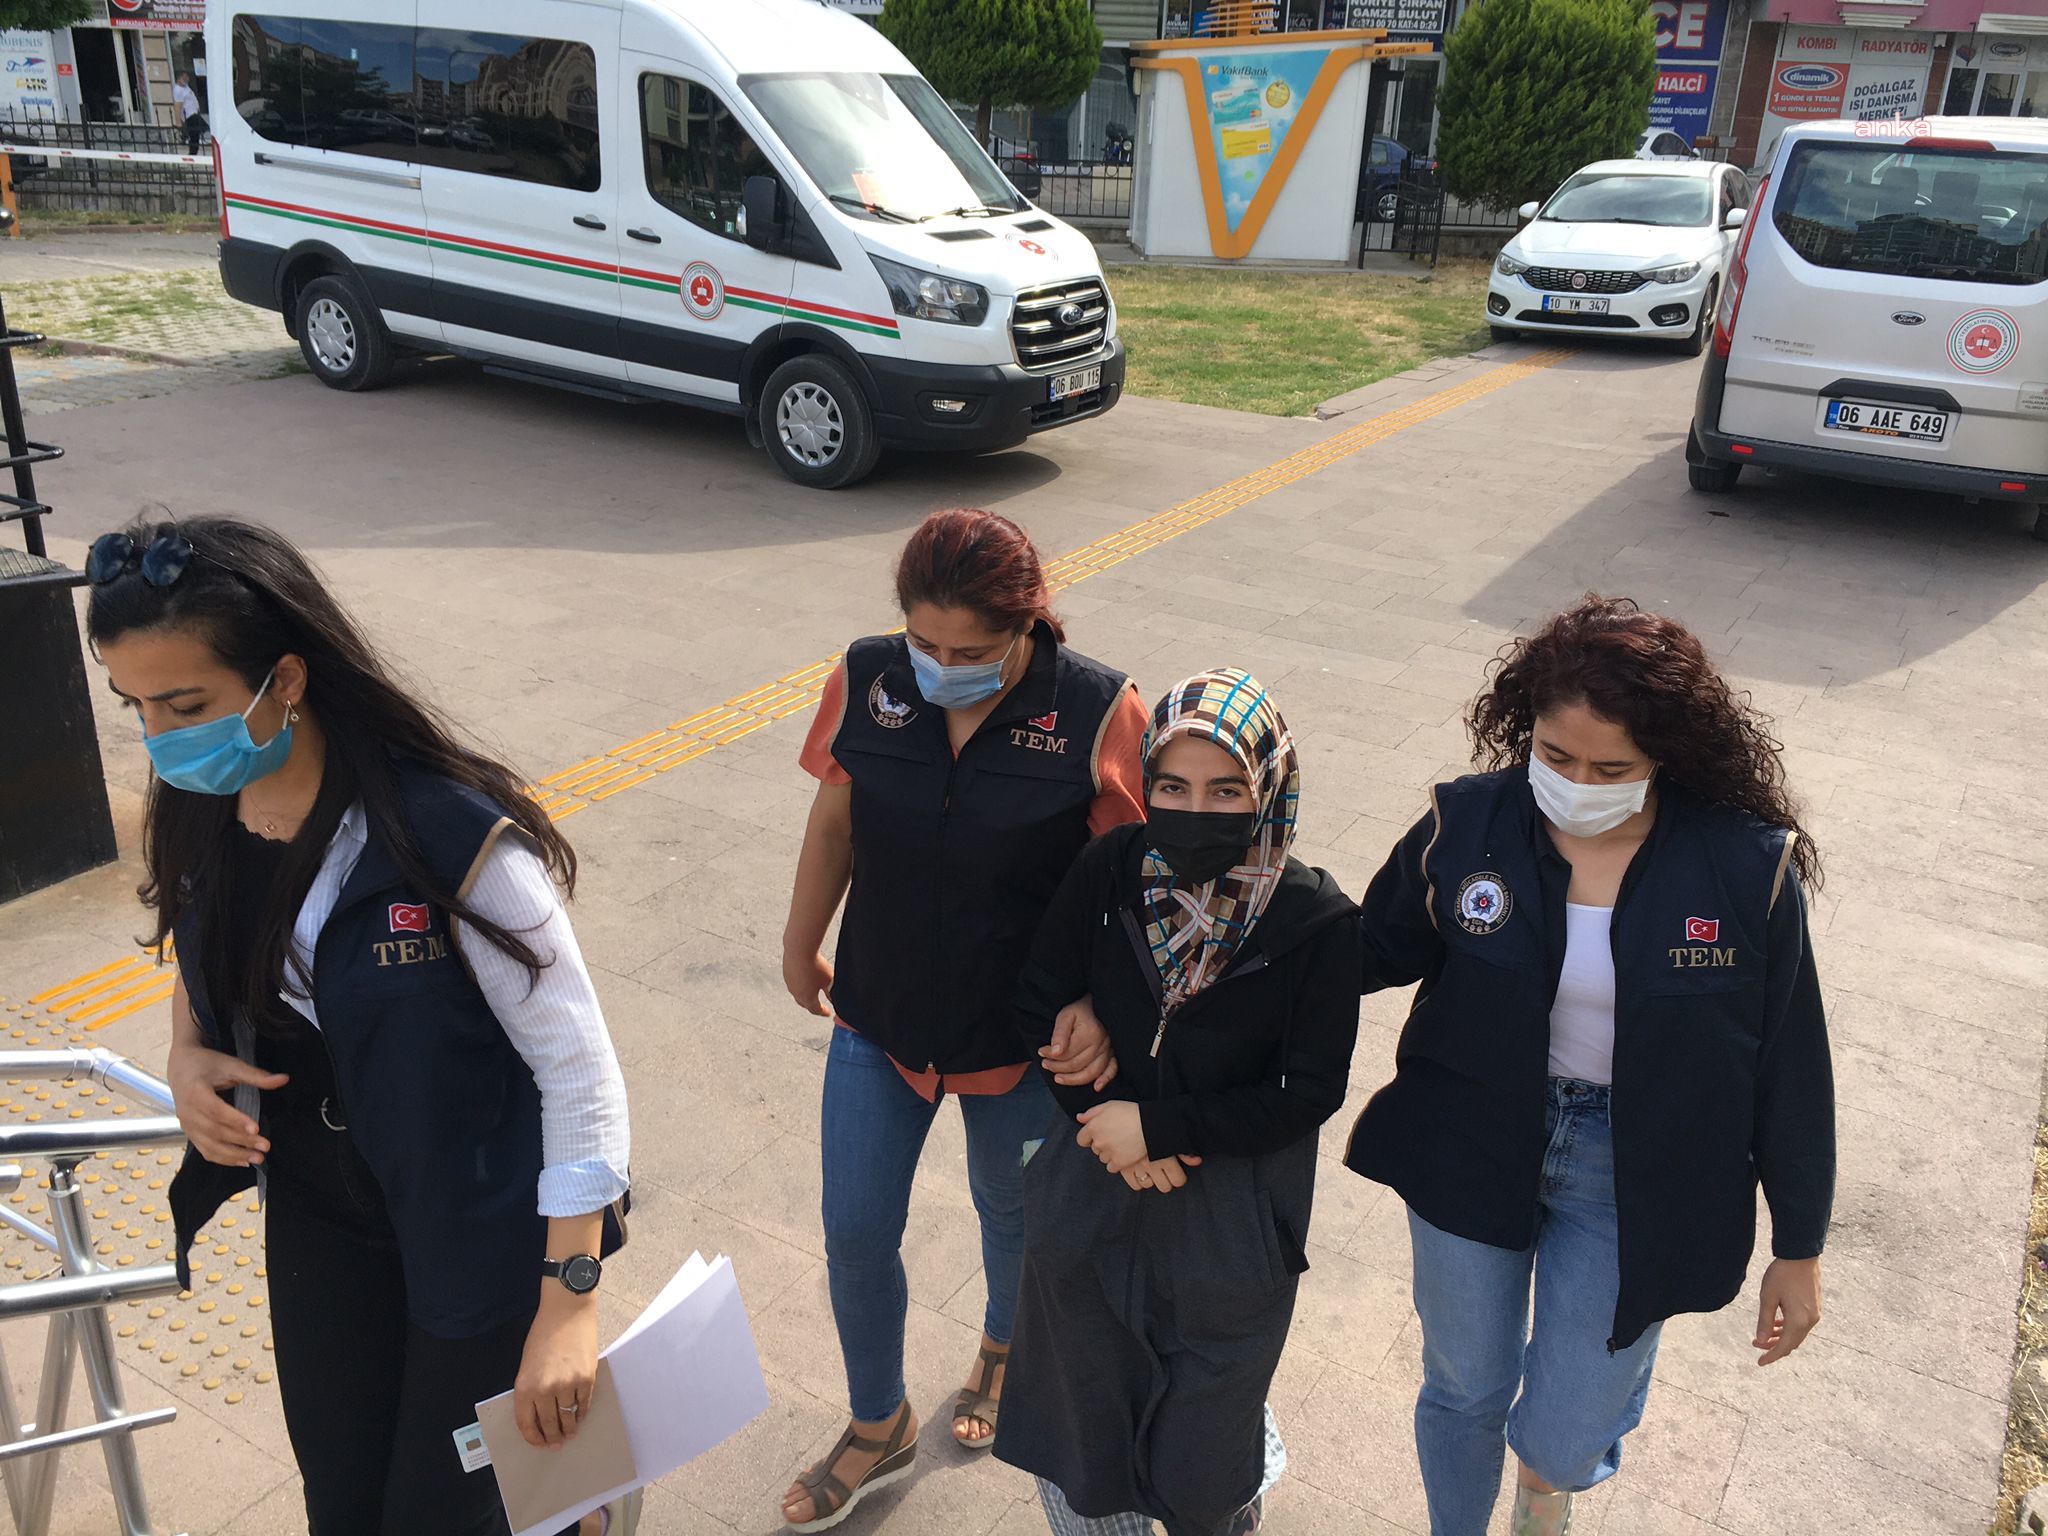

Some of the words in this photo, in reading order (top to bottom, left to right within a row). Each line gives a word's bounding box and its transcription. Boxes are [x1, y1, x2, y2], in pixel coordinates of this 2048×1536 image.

[1353, 8, 1394, 18] GAMZE
[1398, 10, 1438, 19] BULUT
[1861, 38, 1928, 54] RADYATÖR
[1790, 73, 1830, 82] dinamik
[1853, 79, 1915, 97] DOĞALGAZ
[1849, 100, 1864, 111] ISI
[1866, 92, 1918, 108] DANIŞMA
[1550, 299, 1560, 308] 10
[1569, 299, 1580, 309] YM
[1589, 301, 1607, 311] 347
[1055, 378, 1065, 393] 06
[1087, 369, 1100, 385] 115
[1839, 405, 1860, 423] 06
[1870, 409, 1903, 429] AAE
[1910, 414, 1942, 434] 649
[1010, 728, 1068, 754] TEM
[372, 934, 447, 967] TEM
[1668, 947, 1737, 968] TEM
